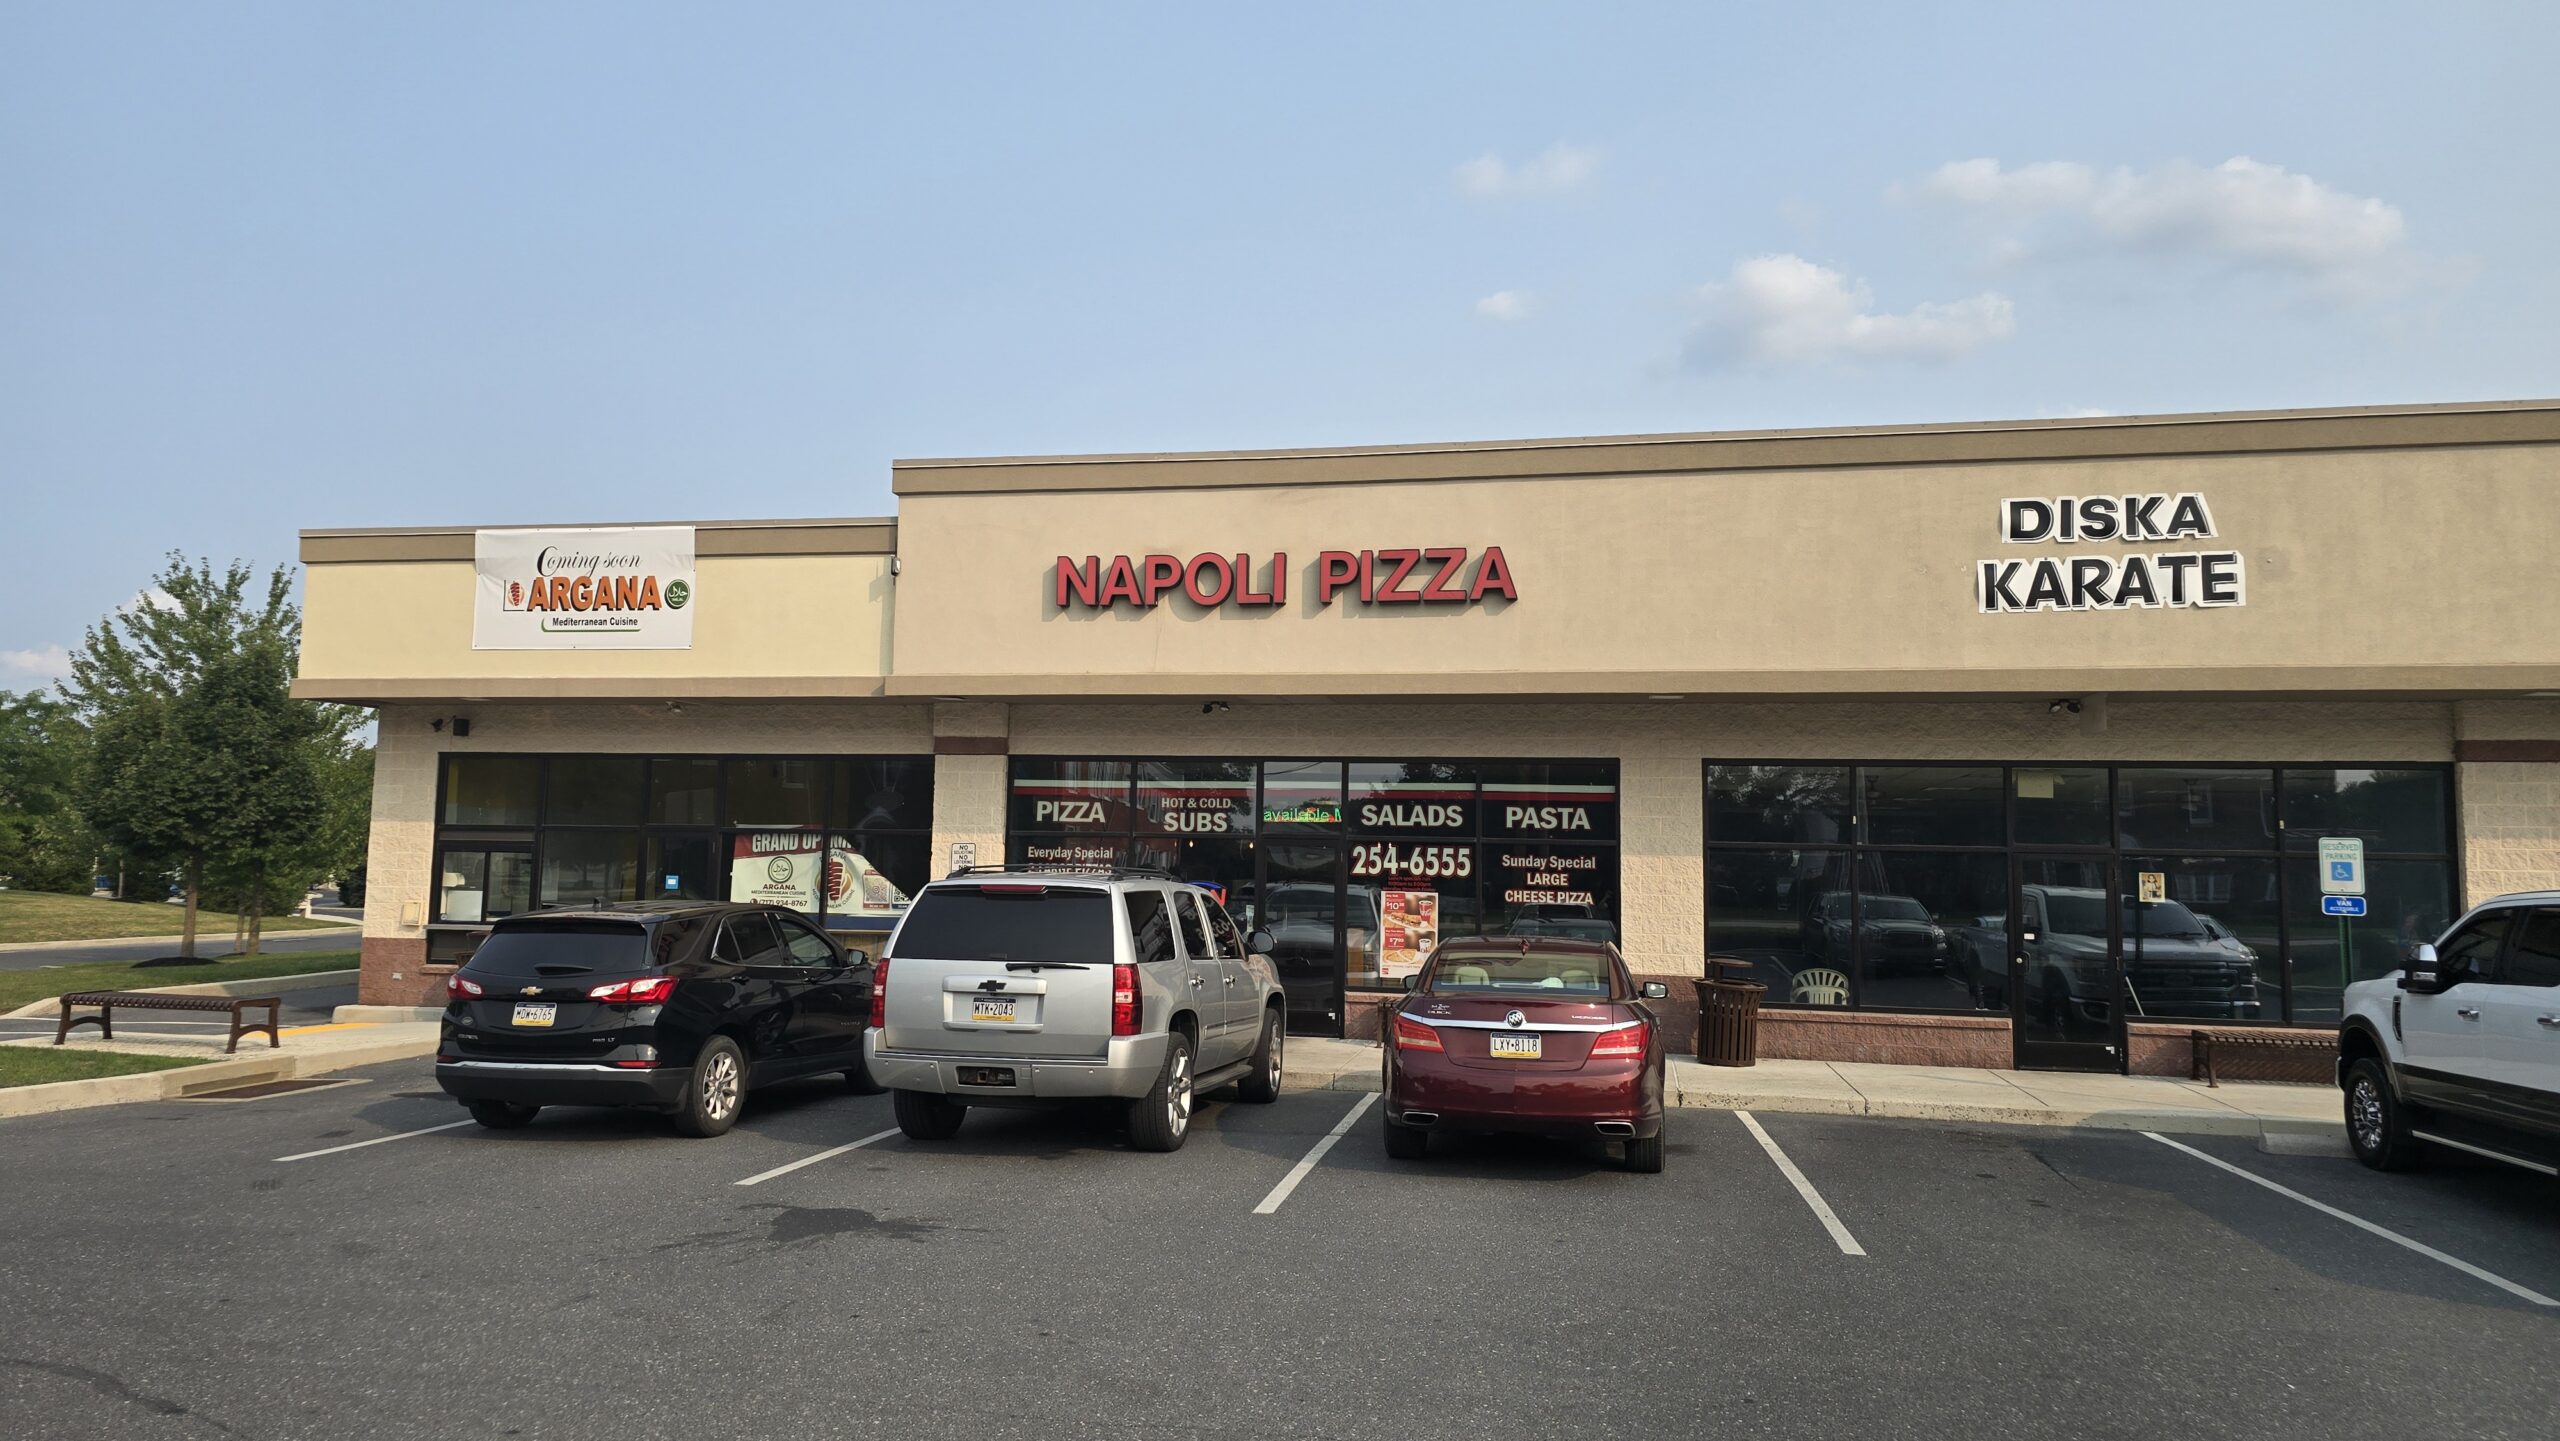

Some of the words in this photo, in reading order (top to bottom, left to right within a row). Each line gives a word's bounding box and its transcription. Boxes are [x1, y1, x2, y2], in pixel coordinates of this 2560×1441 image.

[2009, 495, 2211, 541] DISKA
[536, 545, 599, 577] Coming
[602, 551, 642, 569] soon
[1056, 552, 1287, 607] NAPOLI
[1319, 546, 1518, 605] PIZZA
[1984, 554, 2238, 610] KARATE
[527, 575, 662, 612] ARGANA
[552, 617, 608, 627] Mediterranean
[609, 616, 638, 627] Cuisine
[1036, 801, 1106, 823] PIZZA
[1161, 797, 1186, 809] HOT
[1187, 798, 1197, 809] &
[1199, 797, 1231, 809] COLD
[1163, 812, 1229, 833] SUBS
[1361, 804, 1464, 828] SALADS
[1505, 806, 1591, 830] PASTA
[752, 833, 799, 853] GRAND
[1027, 846, 1073, 860] Everyday
[1074, 846, 1113, 861] Special
[1352, 845, 1472, 877] 254-6555
[1502, 854, 1548, 869] Sunday
[1549, 854, 1596, 870] Special
[762, 883, 797, 891] ARGANA
[1526, 873, 1569, 886] LARGE
[1504, 890, 1555, 904] CHEESE
[1556, 891, 1594, 905] PIZZA
[2335, 899, 2353, 907] VAN
